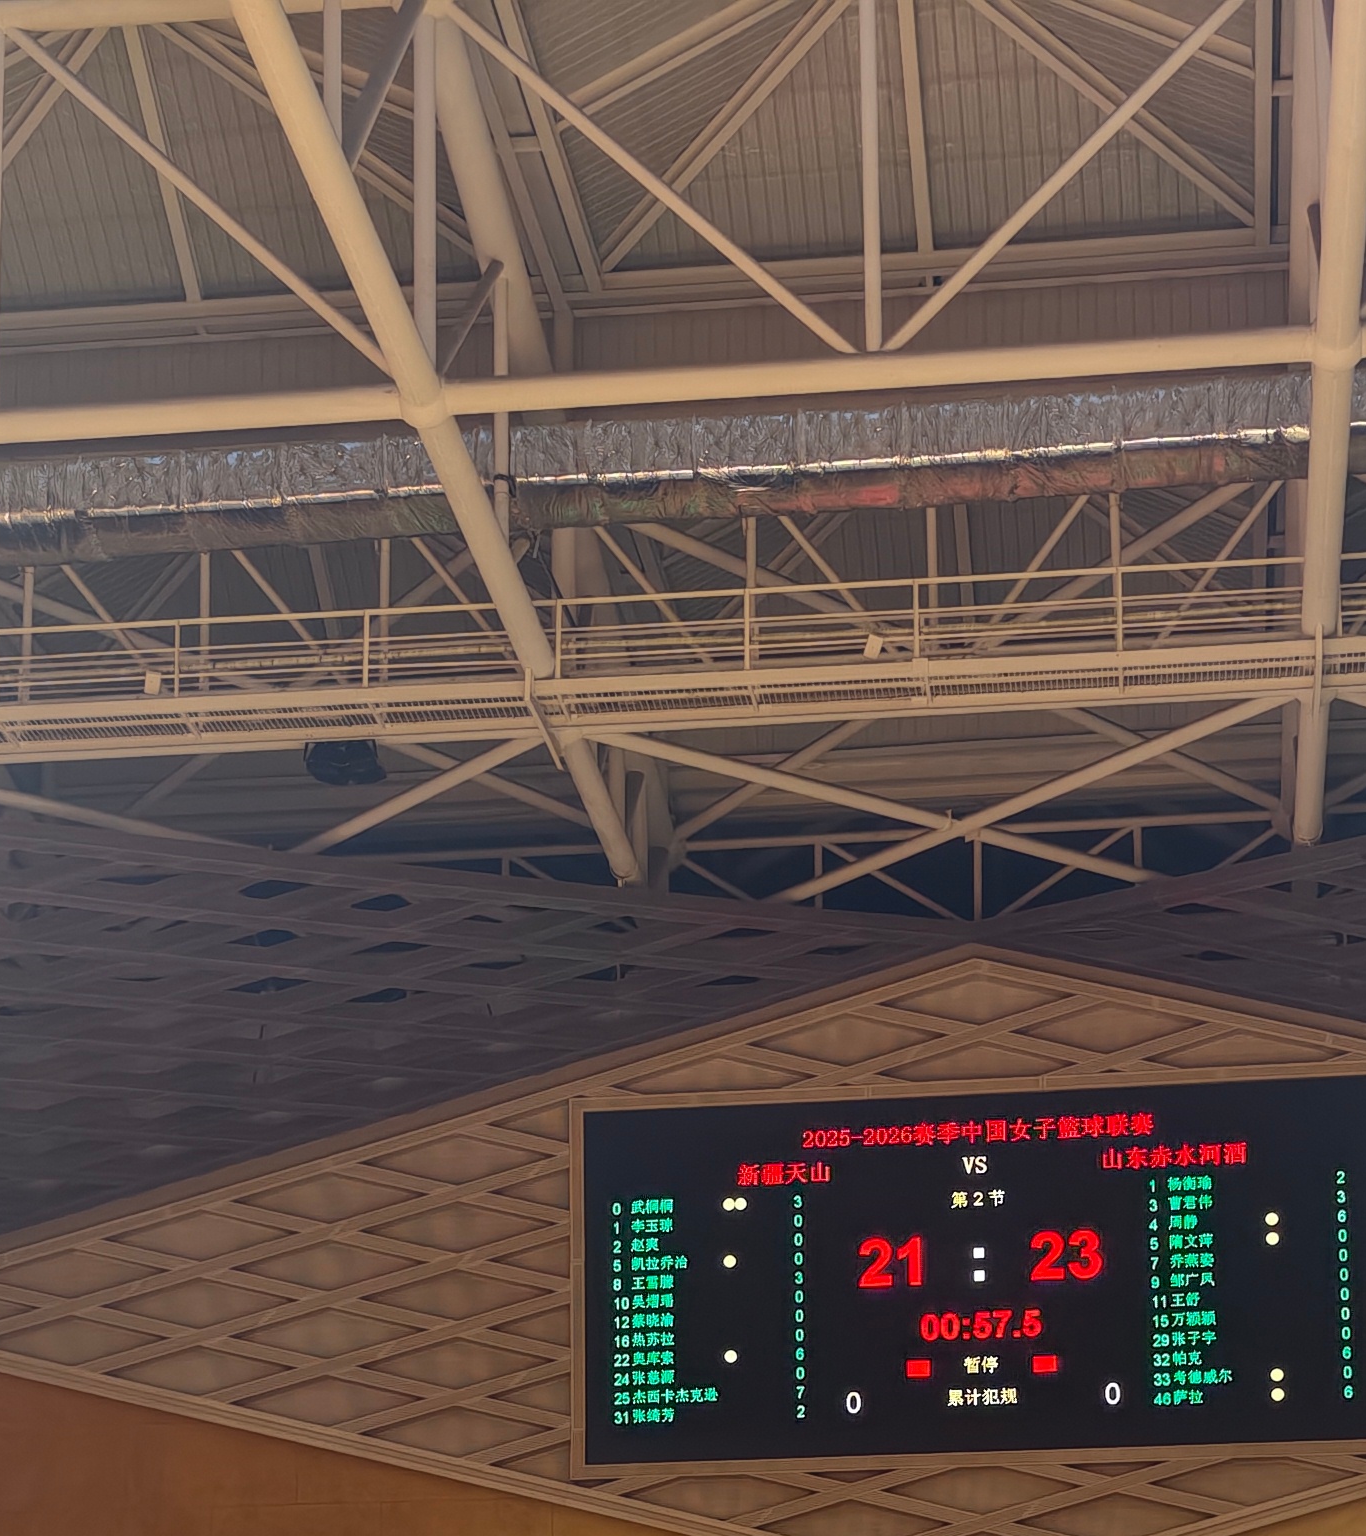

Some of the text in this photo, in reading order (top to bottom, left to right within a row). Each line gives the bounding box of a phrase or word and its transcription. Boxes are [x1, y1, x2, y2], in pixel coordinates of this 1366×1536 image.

[802, 1112, 1155, 1149] 2025-2026赛季中国女子篮球联赛
[962, 1155, 988, 1174] VS
[1102, 1141, 1247, 1171] 山东赤水河酒
[737, 1161, 832, 1186] 新疆天山
[1149, 1179, 1156, 1193] 1
[1336, 1170, 1346, 1185] 2
[612, 1202, 622, 1216] 0
[793, 1194, 803, 1209] 3
[1148, 1198, 1158, 1213] 3
[1336, 1189, 1347, 1204] 3
[613, 1221, 620, 1235] 1
[793, 1214, 803, 1228] 0
[1148, 1218, 1159, 1232] 4
[1337, 1209, 1347, 1223] 6
[612, 1240, 622, 1254] 2
[793, 1232, 803, 1247] 0
[1149, 1236, 1159, 1251] 5
[1337, 1228, 1348, 1243] 0
[612, 1258, 622, 1273] 5
[793, 1251, 804, 1266] 0
[858, 1236, 923, 1288] 21
[1030, 1229, 1104, 1281] 23
[1150, 1256, 1159, 1270] 7
[1338, 1248, 1349, 1262] 0
[612, 1278, 622, 1292] 8
[794, 1271, 804, 1285] 3
[1150, 1275, 1160, 1289] 9
[1339, 1267, 1349, 1282] 0
[613, 1296, 630, 1311] 10
[794, 1289, 804, 1304] 0
[1152, 1294, 1167, 1309] 11
[1340, 1287, 1350, 1301] 0
[614, 1315, 630, 1330] 12
[795, 1309, 804, 1323] 0
[920, 1309, 1042, 1341] 00:57.5
[1152, 1314, 1169, 1329] 15
[1340, 1306, 1351, 1321] 0
[614, 1334, 630, 1349] 16
[795, 1328, 805, 1342] 0
[1152, 1333, 1170, 1348] 29
[1341, 1326, 1351, 1340] 0
[613, 1353, 631, 1368] 22
[795, 1347, 805, 1361] 6
[964, 1356, 999, 1374] 暂停
[1152, 1345, 1352, 1367] 32 帕克 6
[613, 1372, 630, 1387] 24
[795, 1366, 805, 1380] 0
[1153, 1372, 1171, 1387] 33
[1343, 1365, 1353, 1380] 0
[613, 1385, 805, 1406] 25 杰西卡杰克逊 7
[846, 1382, 1121, 1414] 0 累计犯规 0
[1153, 1384, 1354, 1406] 46 萨拉 6
[613, 1410, 629, 1425] 31
[796, 1404, 806, 1419] 2
